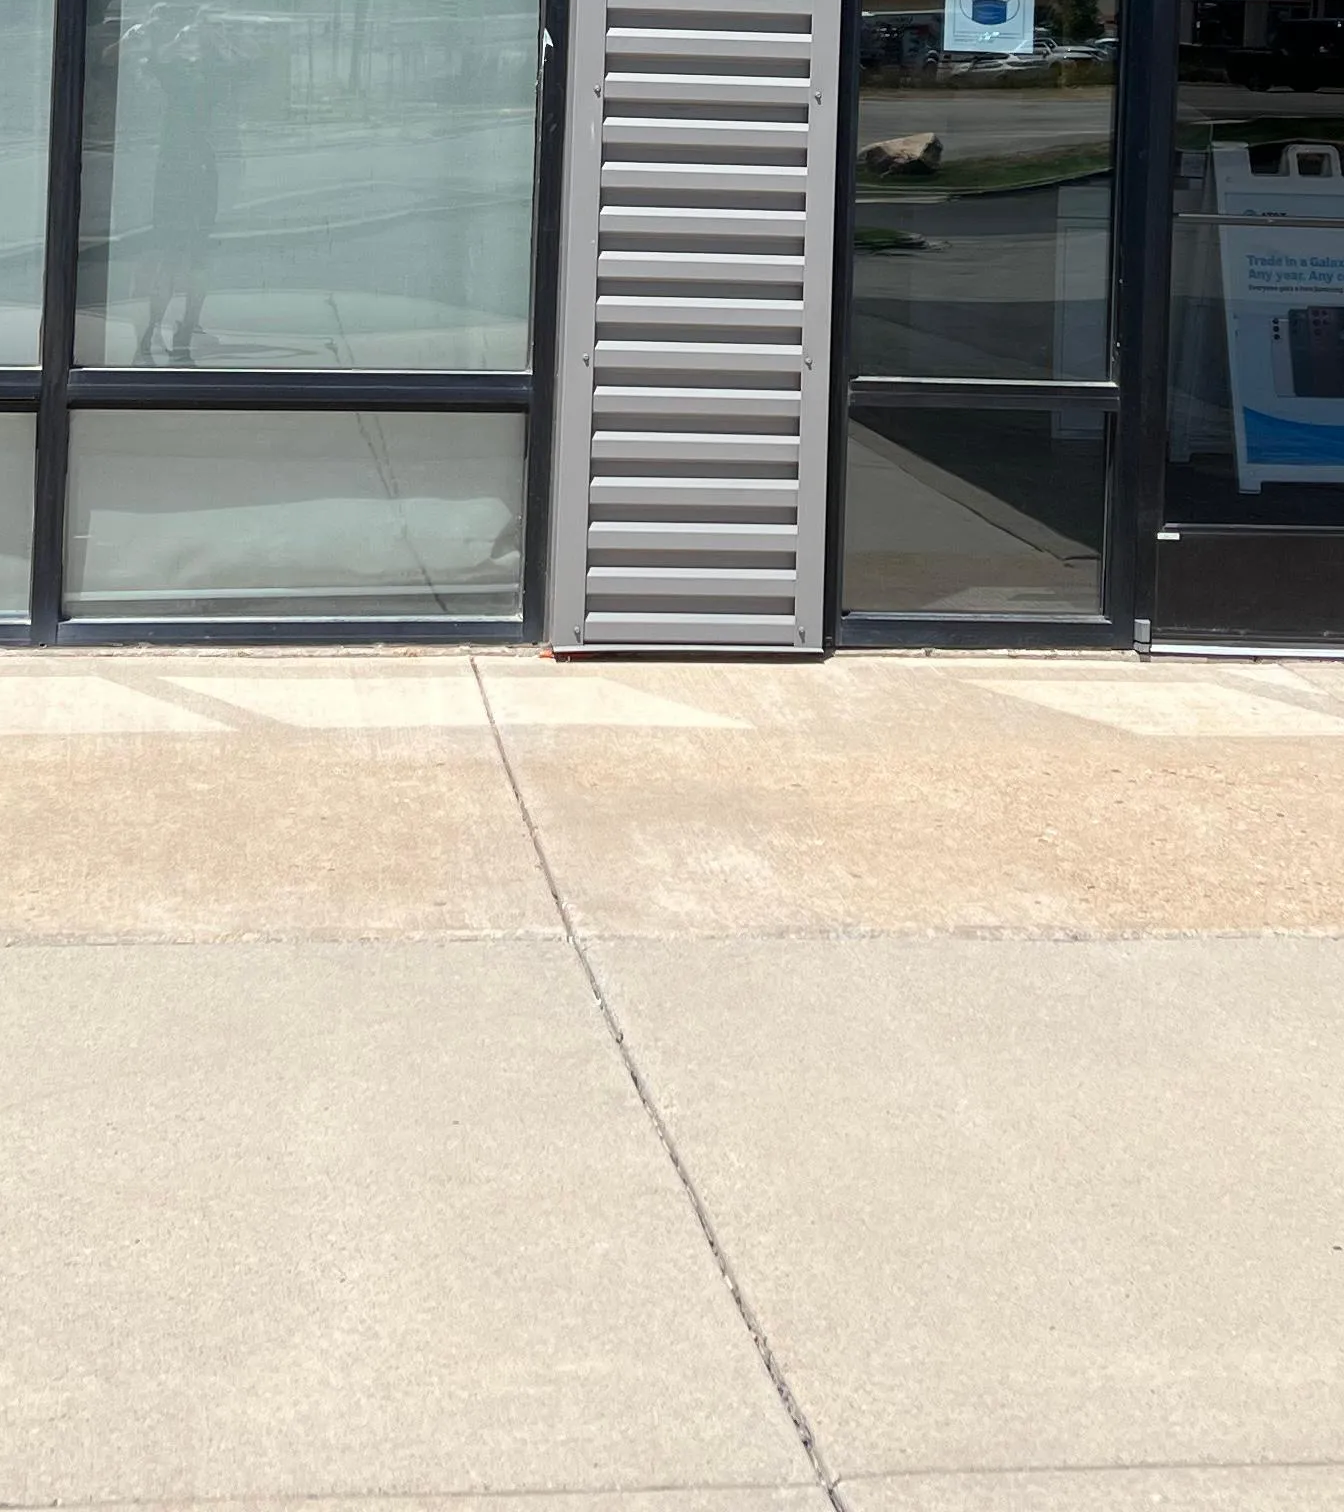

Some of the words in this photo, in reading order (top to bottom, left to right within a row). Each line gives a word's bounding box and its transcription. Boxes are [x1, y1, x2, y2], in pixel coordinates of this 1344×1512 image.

[1246, 255, 1283, 267] Trade
[1285, 255, 1296, 267] in
[1300, 259, 1308, 267] a
[1248, 269, 1273, 282] Any
[1276, 272, 1307, 283] year.
[1309, 271, 1334, 284] Any
